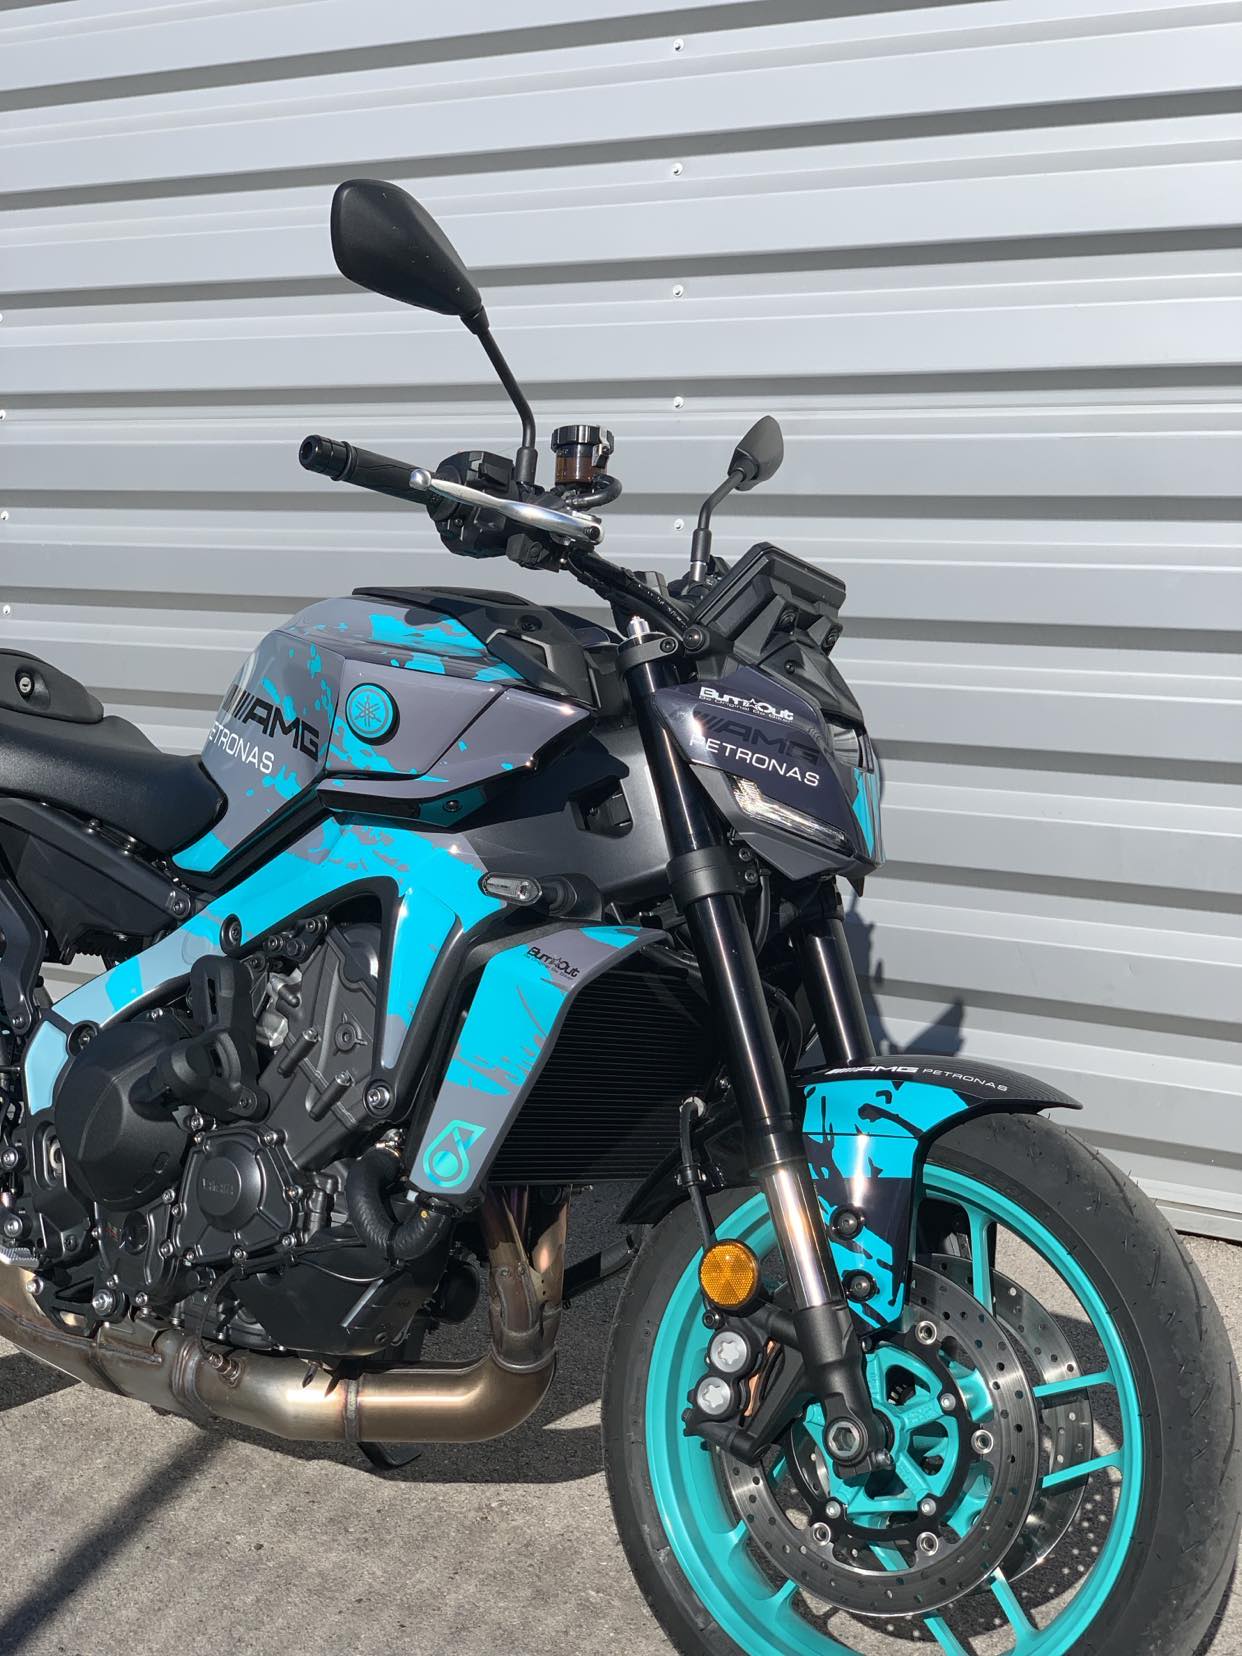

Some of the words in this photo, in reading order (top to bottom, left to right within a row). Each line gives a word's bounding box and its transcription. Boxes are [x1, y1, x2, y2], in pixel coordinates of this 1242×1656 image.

[209, 721, 275, 774] ETRONAS
[242, 696, 320, 762] AMG
[713, 720, 820, 766] AMG
[690, 734, 820, 787] PETRONAS
[922, 1069, 1008, 1092] PETRONAS
